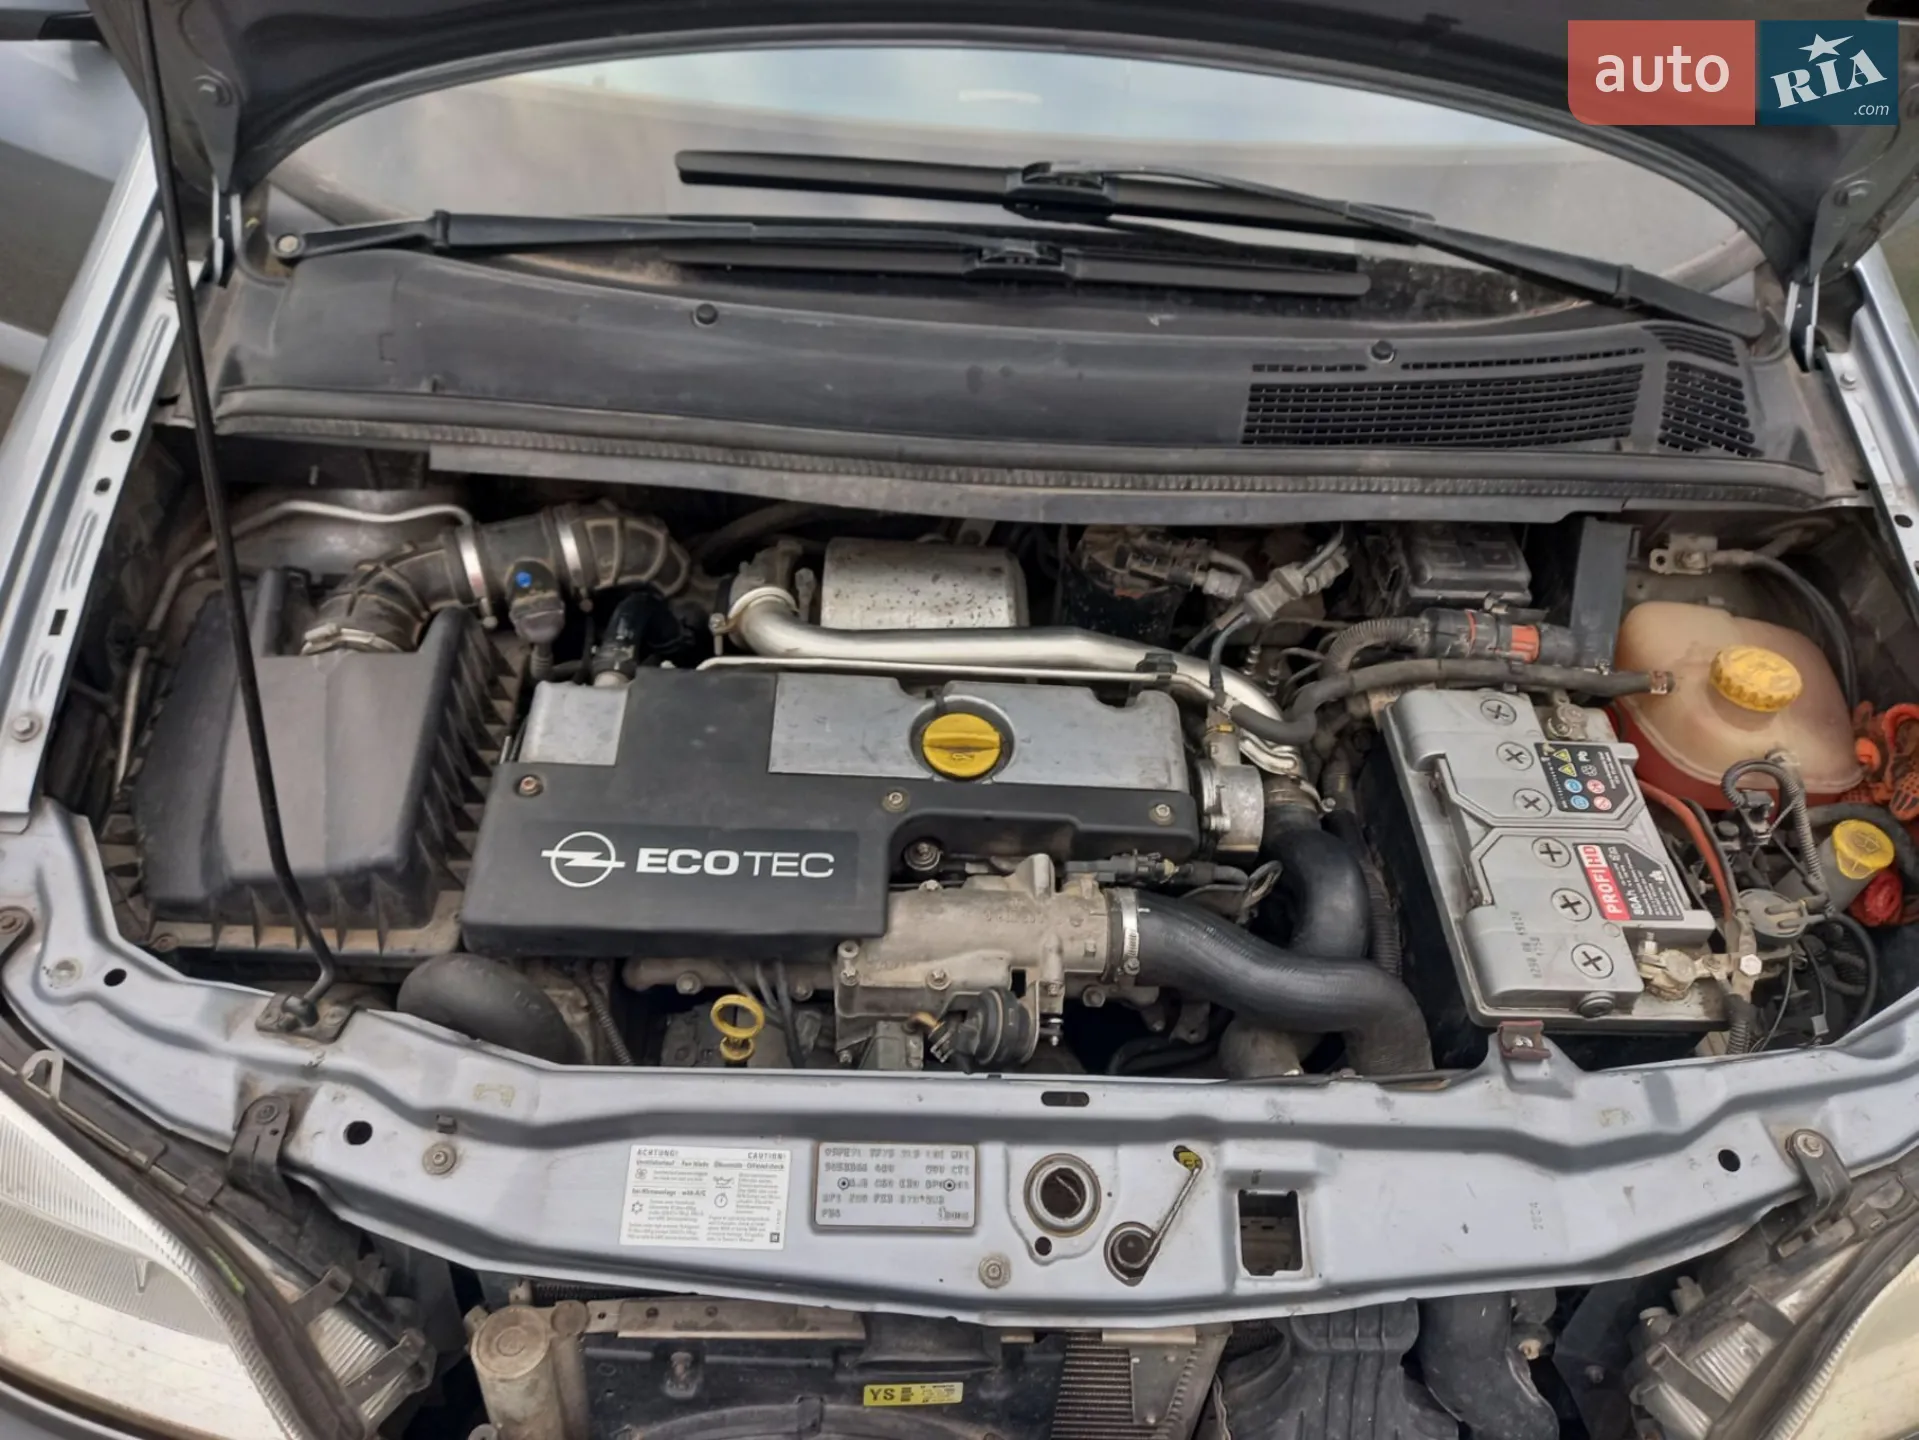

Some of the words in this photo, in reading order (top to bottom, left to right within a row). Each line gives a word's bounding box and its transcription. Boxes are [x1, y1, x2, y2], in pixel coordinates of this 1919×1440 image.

[636, 847, 836, 878] ECOTEC
[1591, 868, 1622, 914] PROFI
[747, 1152, 786, 1160] CAUTION!
[869, 1388, 896, 1401] YS
